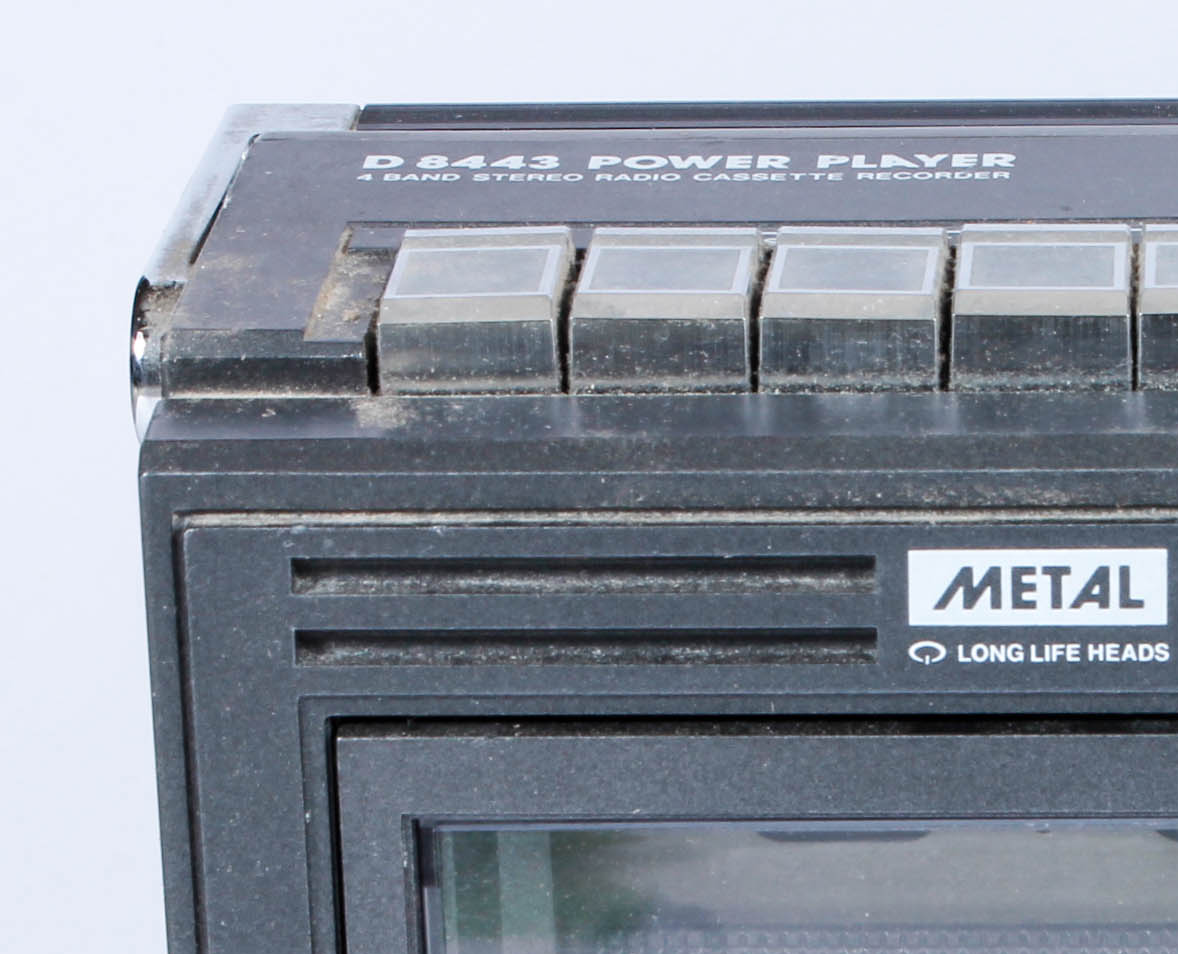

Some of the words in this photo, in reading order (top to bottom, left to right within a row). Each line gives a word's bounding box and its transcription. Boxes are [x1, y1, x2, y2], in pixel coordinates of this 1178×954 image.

[416, 155, 560, 170] 8443
[587, 155, 791, 170] POWER
[816, 153, 1017, 169] PLAYER
[356, 173, 373, 182] 4
[383, 173, 461, 182] BAND
[473, 173, 584, 182] STEREO
[594, 172, 681, 182] RADIO
[693, 172, 843, 181] CASSETTE
[856, 171, 1011, 181] RECORDER
[933, 565, 1145, 611] METAL
[957, 643, 1025, 663] LONG
[1030, 643, 1081, 663] LIFE
[1087, 642, 1170, 662] HEADS
